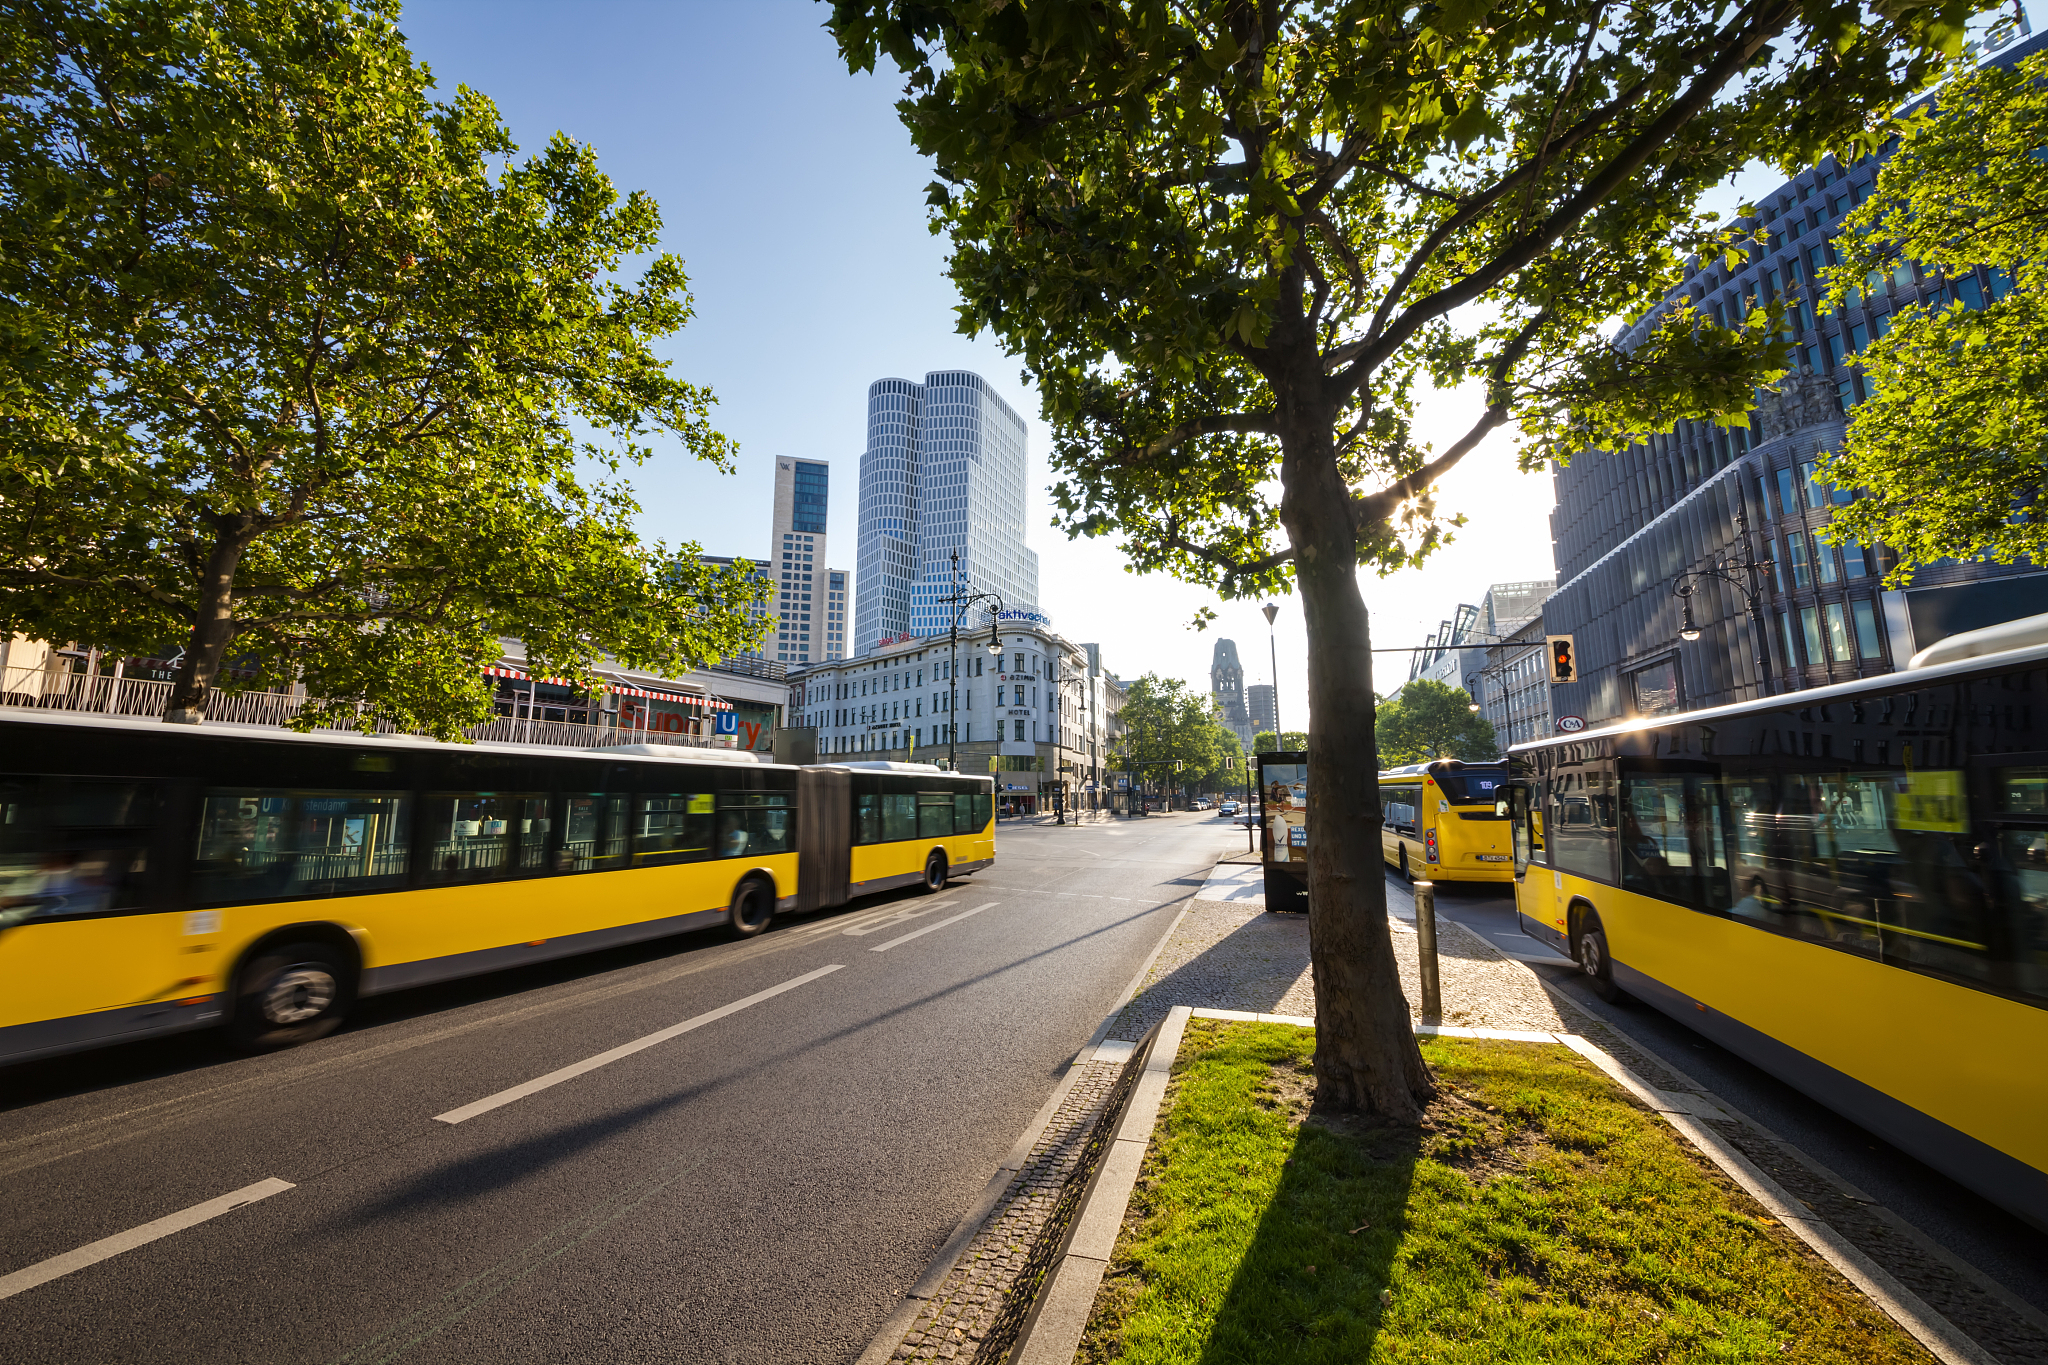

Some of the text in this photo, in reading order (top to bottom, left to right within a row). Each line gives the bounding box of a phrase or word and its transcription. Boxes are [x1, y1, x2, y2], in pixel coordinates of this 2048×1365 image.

[152, 669, 173, 680] THE
[722, 714, 736, 732] U
[1563, 719, 1581, 729] C&A
[1480, 781, 1492, 790] 109
